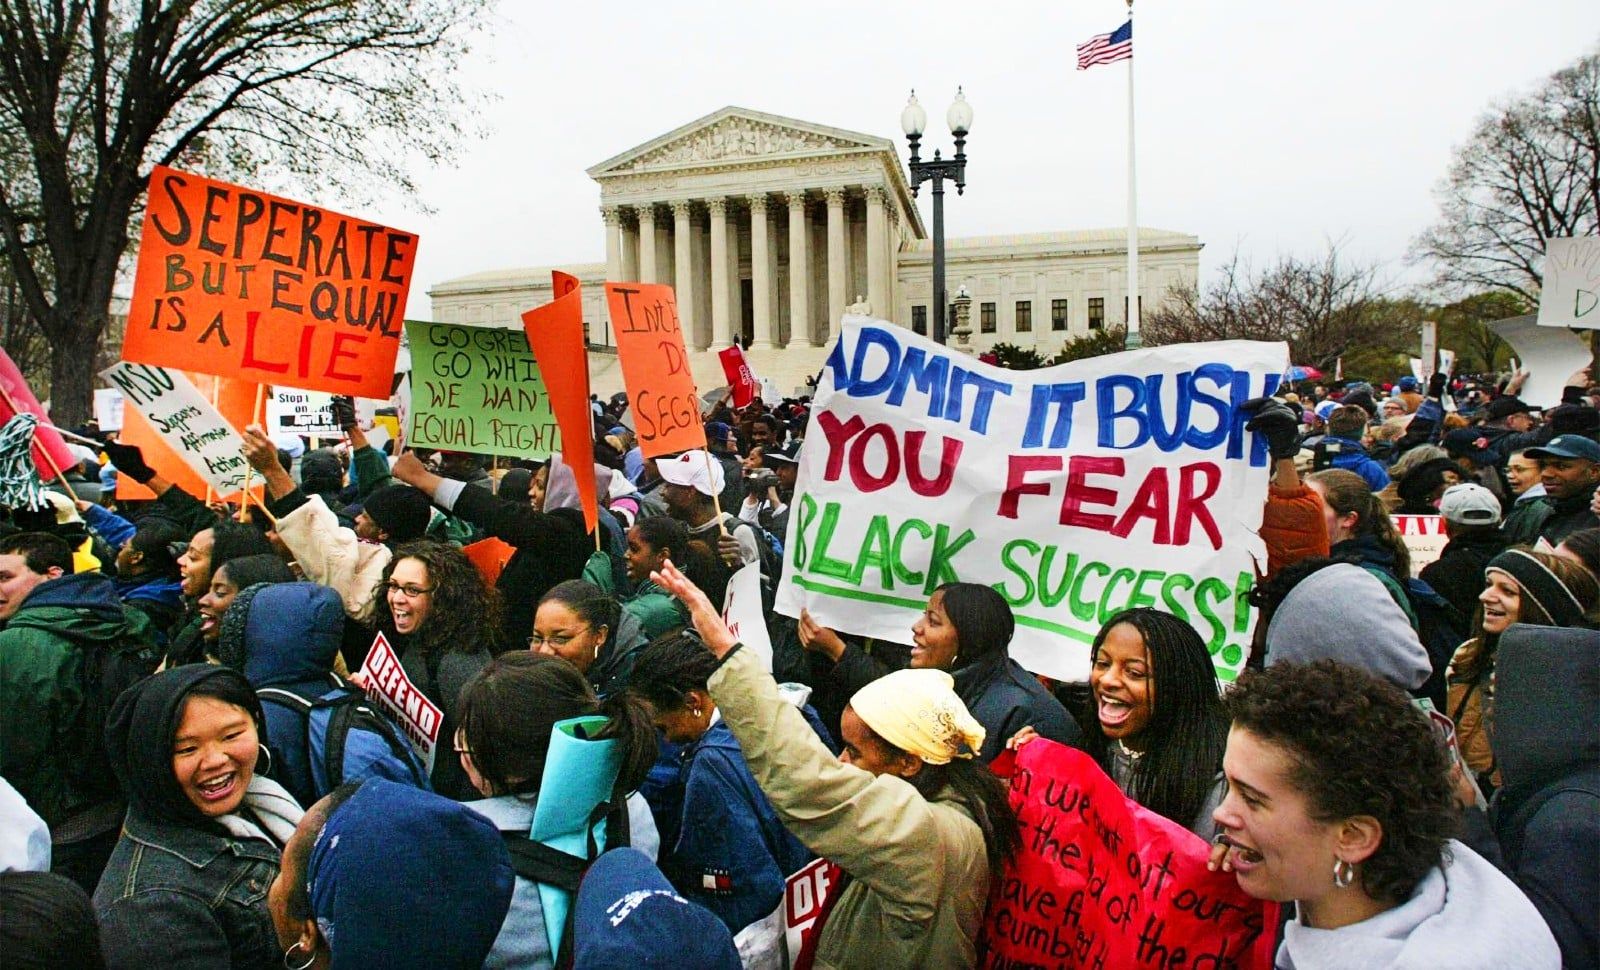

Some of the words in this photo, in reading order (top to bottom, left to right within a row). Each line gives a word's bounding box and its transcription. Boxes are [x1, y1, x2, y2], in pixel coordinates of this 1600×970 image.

[152, 175, 411, 285] SEPERATE
[165, 254, 255, 299] BUT
[271, 269, 400, 339] EQUAL
[429, 325, 469, 348] GO
[149, 297, 187, 331] IS
[198, 311, 231, 347] A
[242, 311, 367, 383] LIE
[433, 352, 471, 378] GO
[480, 353, 537, 382] WHI
[279, 393, 303, 403] Stop
[411, 412, 488, 446] EQUAL
[487, 418, 561, 451] RIGHT
[425, 381, 462, 409] WE
[481, 382, 553, 414] WANT
[823, 326, 1012, 436] ADMIT
[1021, 381, 1086, 449] IT
[1096, 362, 1284, 467] BUSH
[816, 409, 963, 497] YOU
[997, 455, 1223, 550] FEAR
[792, 492, 975, 597] BLACK
[997, 539, 1254, 667] SUCCESS!
[369, 641, 436, 736] DEFEND
[1045, 778, 1091, 825] we
[1033, 813, 1081, 871] the
[1106, 892, 1139, 934] of
[1137, 912, 1187, 970] the
